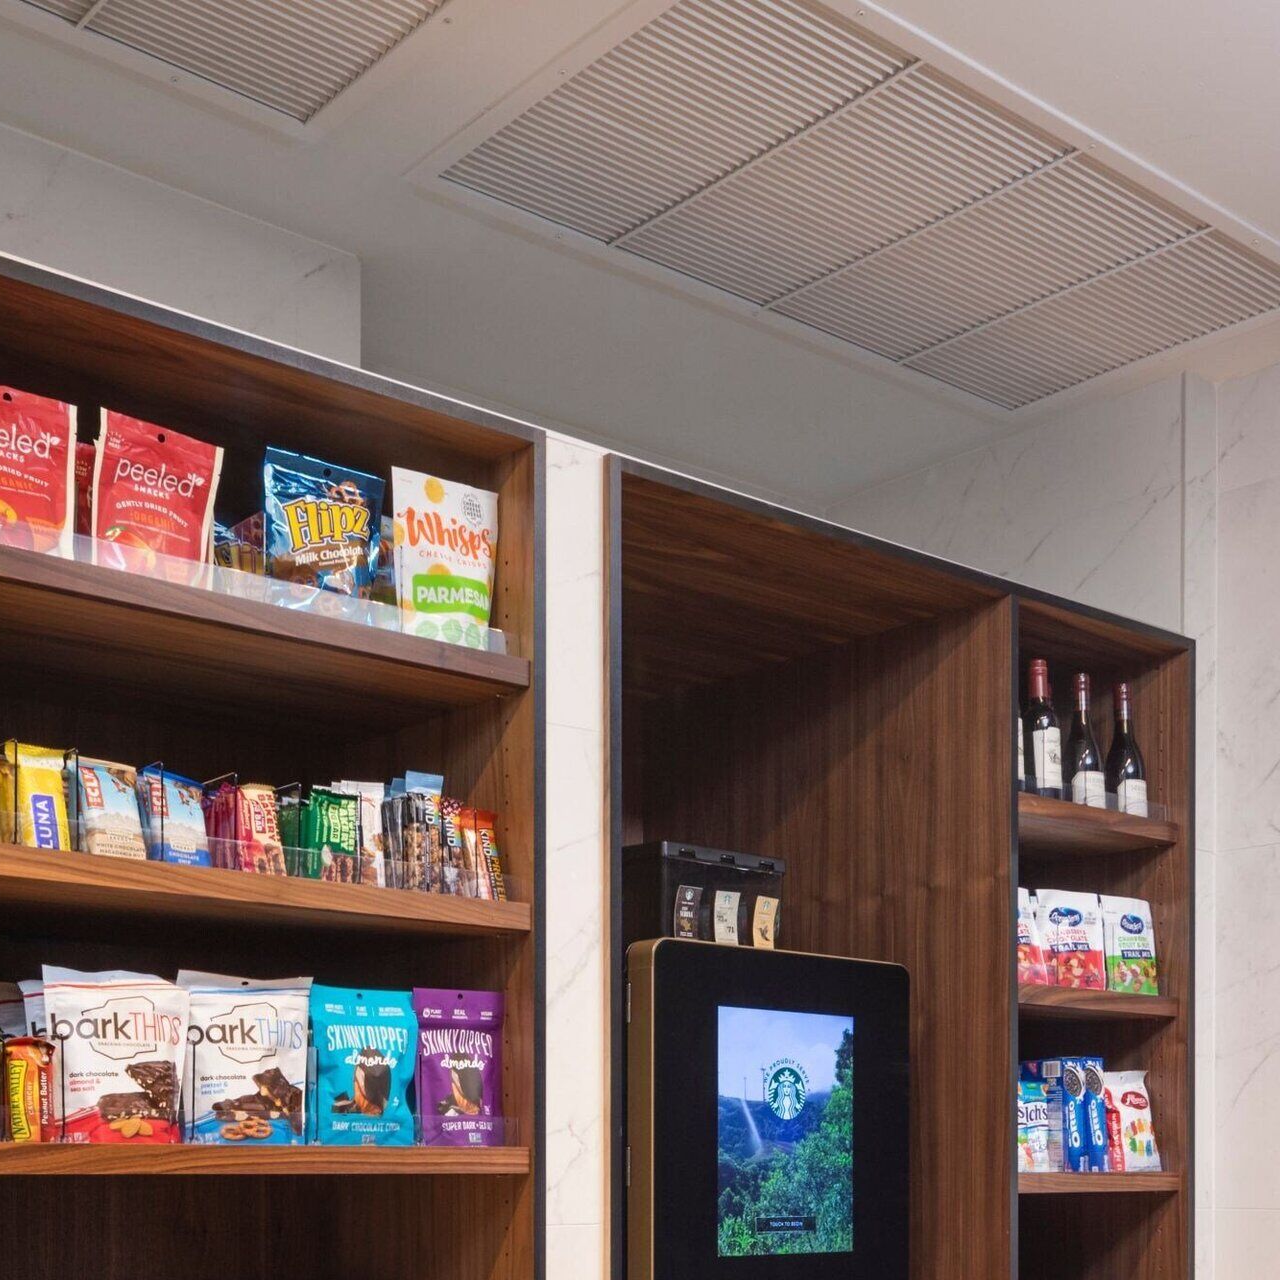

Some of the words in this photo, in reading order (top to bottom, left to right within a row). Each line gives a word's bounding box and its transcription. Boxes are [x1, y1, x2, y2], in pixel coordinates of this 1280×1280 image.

[114, 458, 194, 497] peeled
[134, 484, 170, 500] SNACKS
[283, 498, 370, 553] Flipz
[396, 506, 492, 560] Whisps
[38, 799, 54, 849] LUNA
[424, 795, 436, 825] KIND
[442, 814, 456, 847] KIND
[479, 829, 491, 857] KIND
[344, 1049, 398, 1069] almonds
[440, 1054, 485, 1071] almonds
[40, 1071, 48, 1096] Butter
[69, 1070, 85, 1078] dark
[86, 1070, 119, 1078] chocolate
[41, 1098, 49, 1125] Peanut
